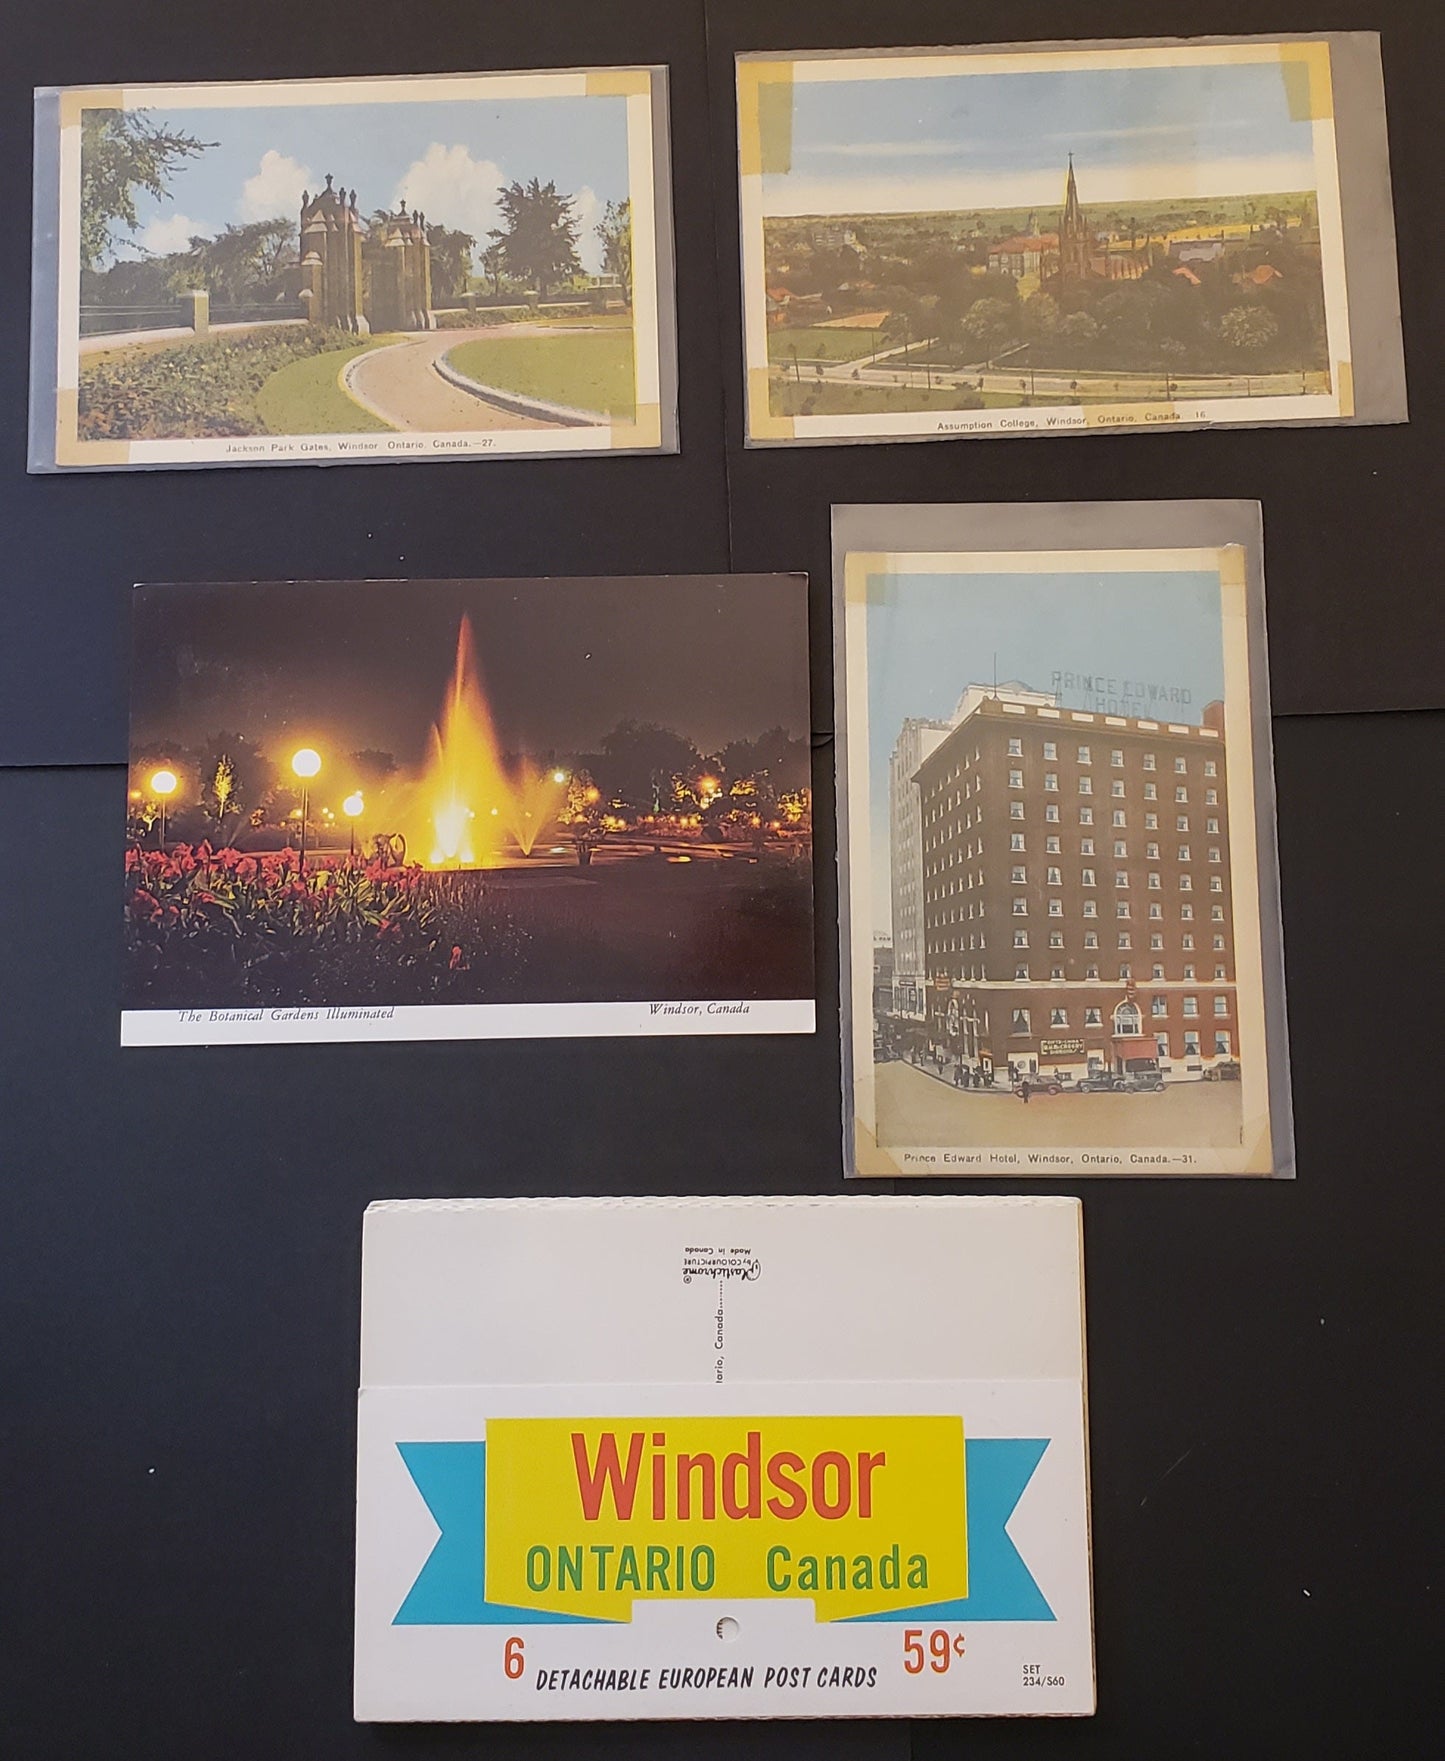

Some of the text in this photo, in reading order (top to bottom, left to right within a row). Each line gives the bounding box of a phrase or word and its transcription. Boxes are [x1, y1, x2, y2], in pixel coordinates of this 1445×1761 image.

[937, 419, 993, 431] Assumption
[999, 417, 1039, 429] College,
[225, 443, 265, 453] Jackson
[270, 442, 295, 452] Park
[1051, 670, 1192, 705] PRINCE EDWARD
[178, 1005, 395, 1023] The Botanical Gardens Illuminated
[649, 1001, 751, 1016] Windsor, Canada
[903, 1153, 936, 1164] Prince
[943, 1152, 982, 1164] Edward
[989, 1153, 1021, 1165] Hotel,
[1027, 1153, 1074, 1165] Windsor,
[1081, 1153, 1123, 1165] Ontario,
[684, 1246, 752, 1256] Made in Canada
[683, 1257, 752, 1267] by COLOURPICTURE
[570, 1431, 887, 1522] Windsor
[525, 1542, 930, 1593] ONTARIO Canada
[503, 1636, 526, 1680] 6
[903, 1628, 966, 1675] 59¢
[1022, 1663, 1042, 1675] SET
[535, 1665, 878, 1692] DETACHABLE EUROPEAN POST CARDS
[1022, 1675, 1066, 1688] 234/S60
